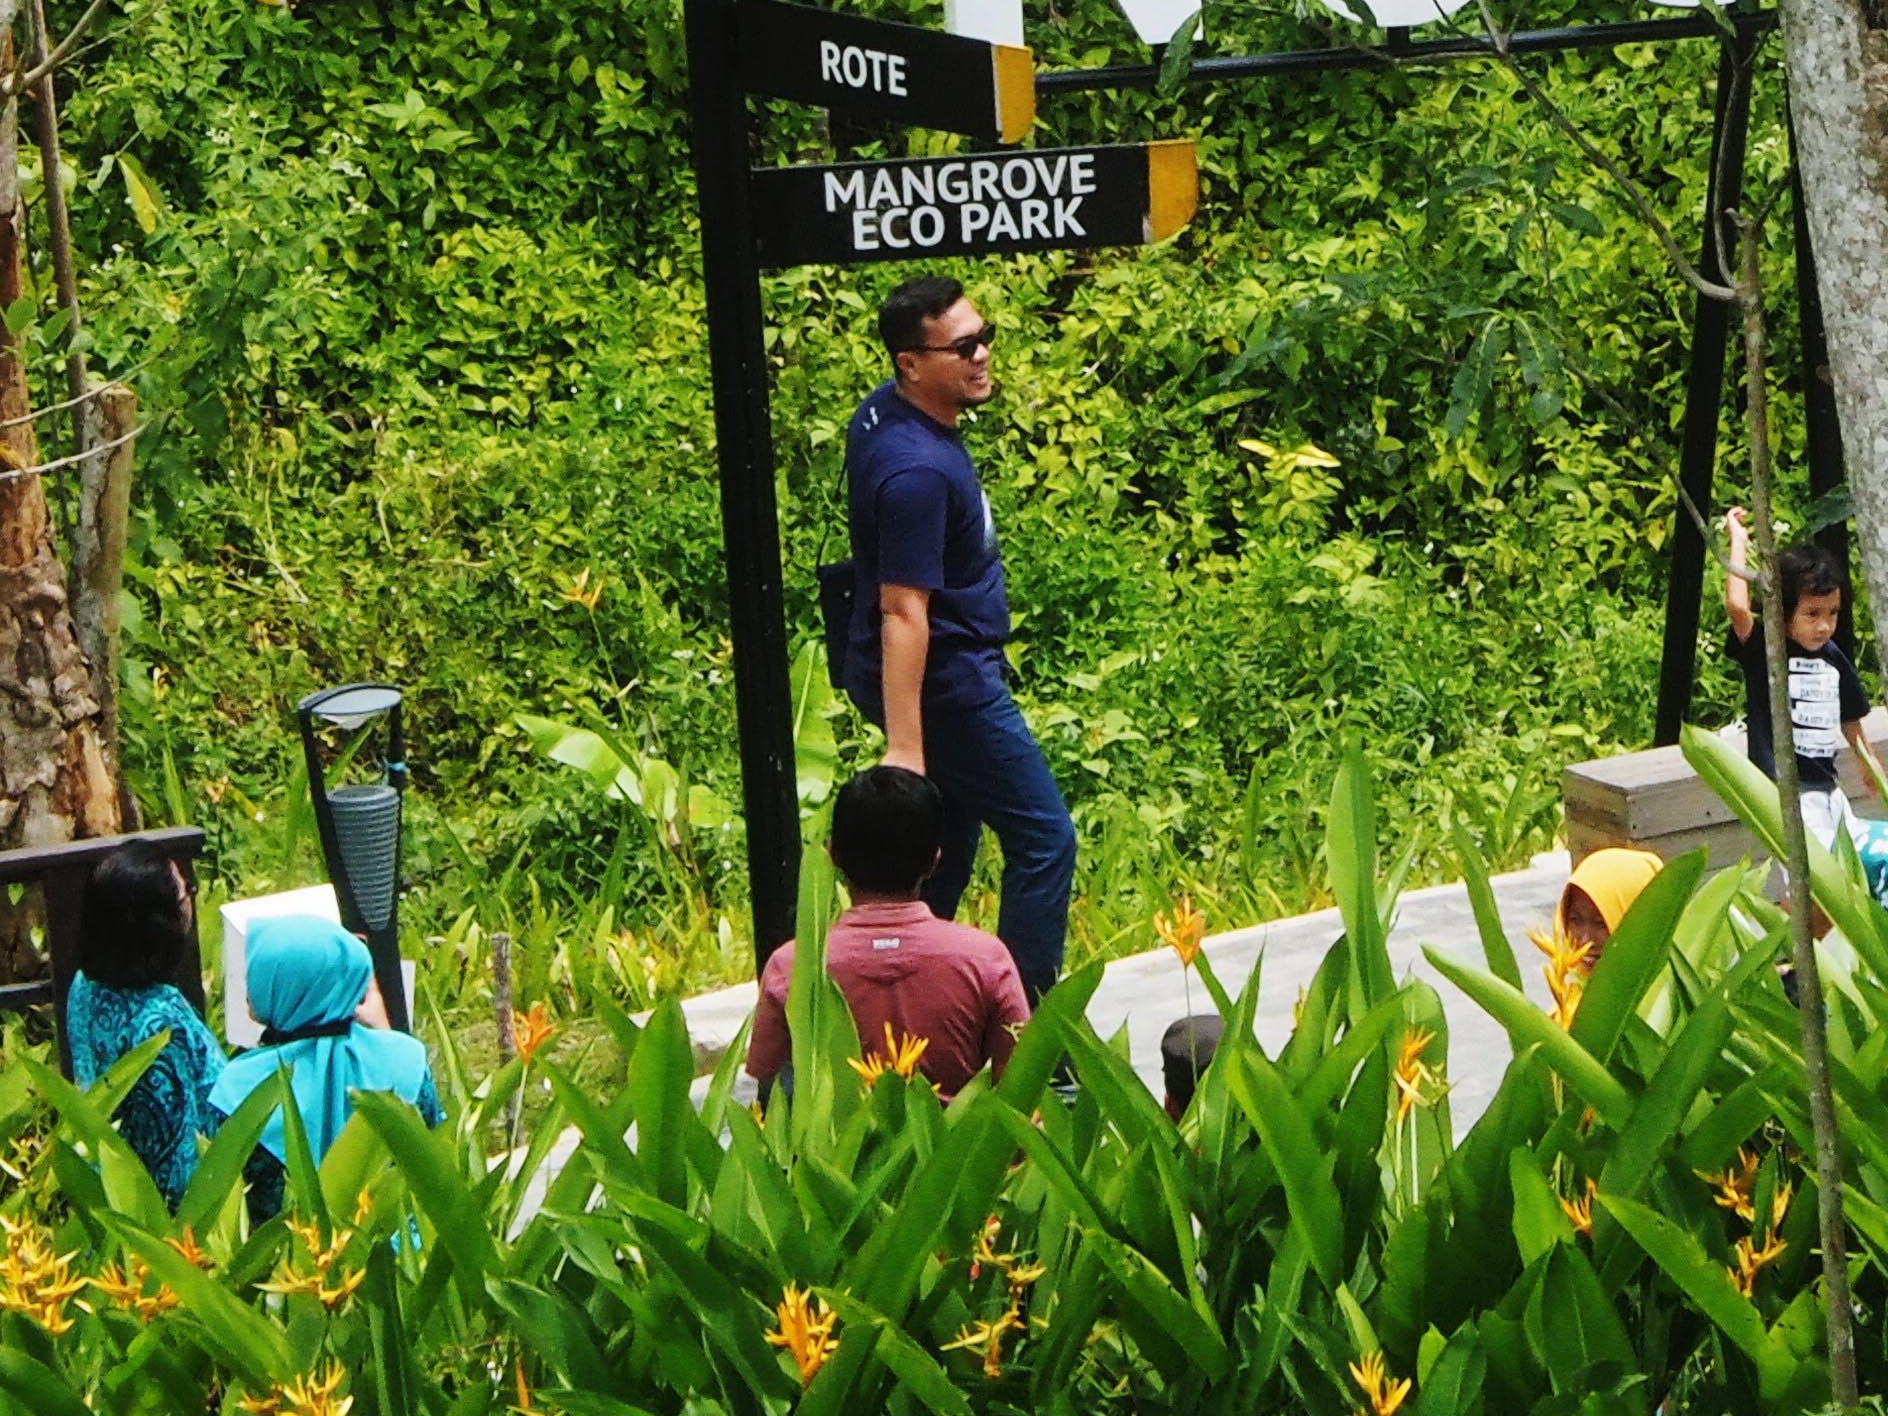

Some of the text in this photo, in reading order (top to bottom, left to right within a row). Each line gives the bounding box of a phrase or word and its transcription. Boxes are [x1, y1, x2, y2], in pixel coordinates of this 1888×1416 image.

[820, 40, 908, 97] ROTE
[823, 153, 1097, 213] MANGROVE
[852, 196, 1087, 251] ECO PARK
